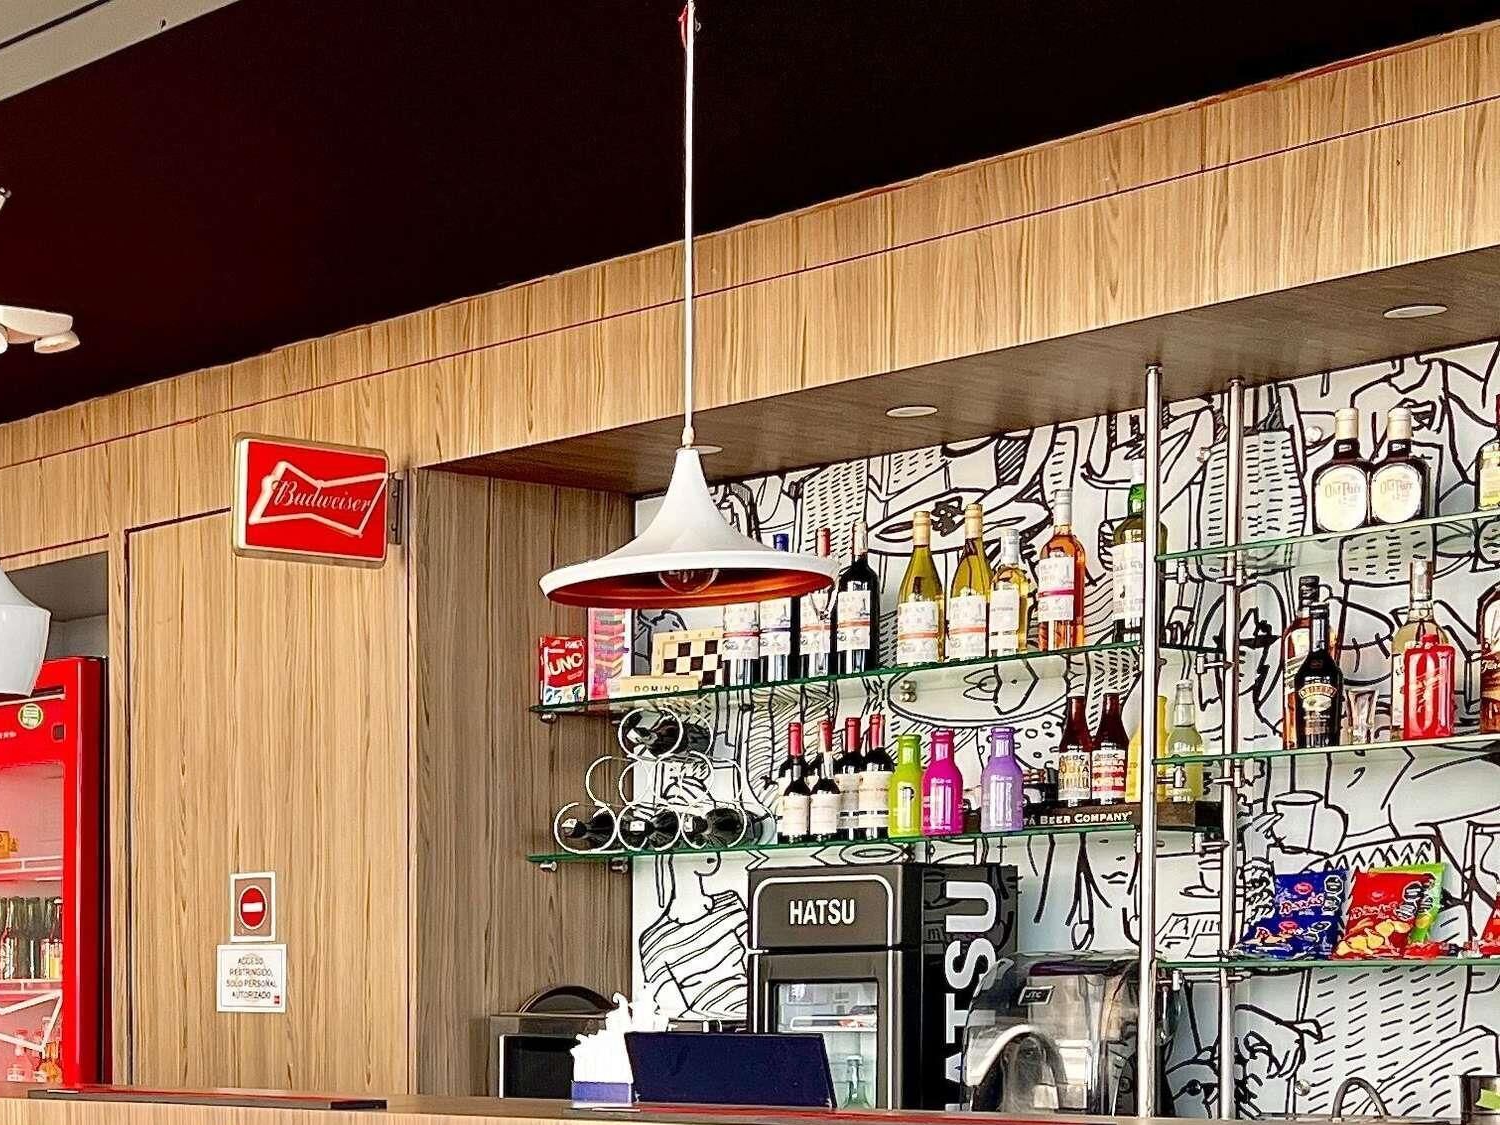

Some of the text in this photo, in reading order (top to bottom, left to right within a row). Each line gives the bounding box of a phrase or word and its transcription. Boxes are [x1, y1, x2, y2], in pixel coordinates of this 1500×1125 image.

[272, 480, 372, 512] Budweiser
[634, 684, 680, 692] DOMINO
[1040, 815, 1071, 825] BEER
[789, 899, 855, 925] HATSU
